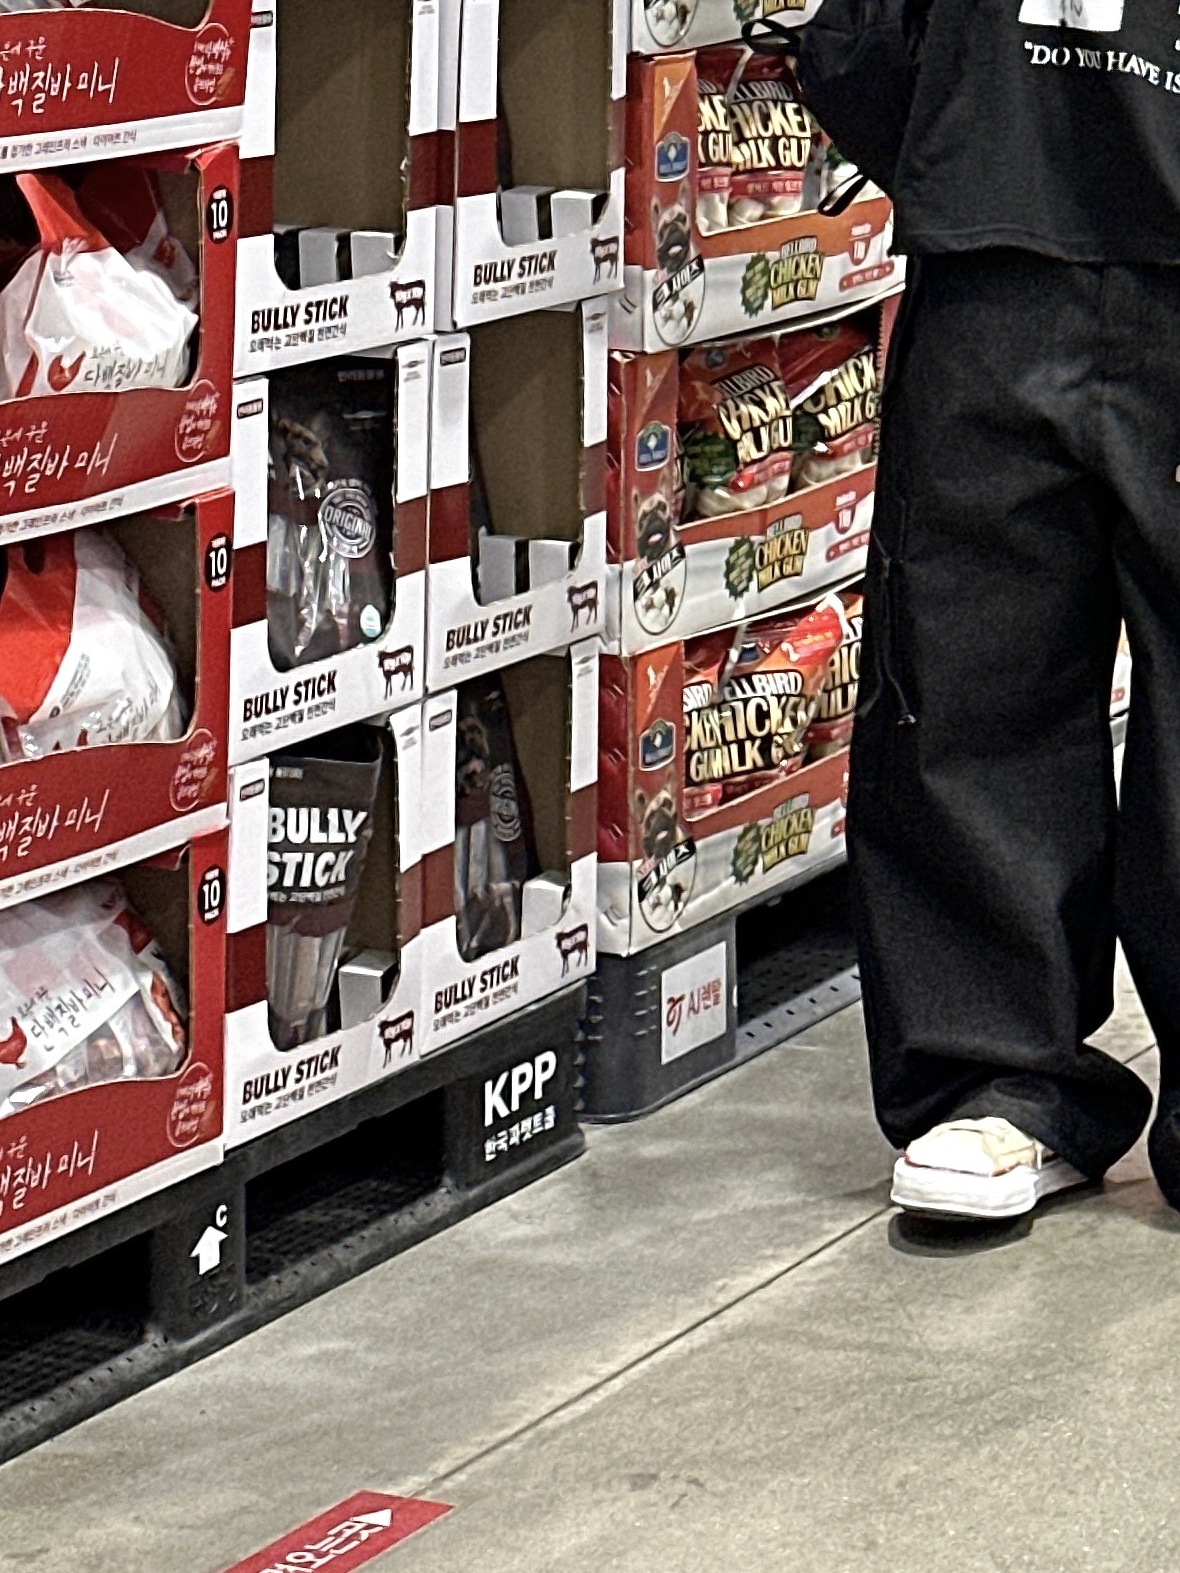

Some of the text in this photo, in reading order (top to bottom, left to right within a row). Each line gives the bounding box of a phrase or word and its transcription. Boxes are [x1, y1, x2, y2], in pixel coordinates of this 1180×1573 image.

[77, 56, 119, 105] 미니
[1106, 49, 1161, 85] HAVE
[211, 200, 228, 230] 10
[473, 250, 557, 288] BULLY STICK
[771, 253, 823, 284] CHICKEN
[793, 276, 818, 302] GUM
[251, 295, 348, 335] BULLY STICK
[75, 432, 118, 476] 미니
[209, 548, 227, 577] 10
[755, 529, 810, 571] CHICKEN
[445, 621, 490, 653] BULLY
[492, 604, 532, 637] STICK
[243, 688, 291, 723] BULLY
[293, 670, 337, 704] STICK
[64, 790, 109, 832] 미니
[268, 807, 368, 844] BULLY
[267, 849, 354, 888] STICK
[203, 878, 220, 910] 10
[83, 969, 115, 1000] 미니
[433, 980, 479, 1014] BULLY
[480, 955, 520, 992] STICK
[242, 1063, 292, 1106] BULLY
[294, 1044, 342, 1087] STICK
[483, 1050, 558, 1128] KPP
[58, 1129, 99, 1177] 미니
[215, 1204, 228, 1226] C
